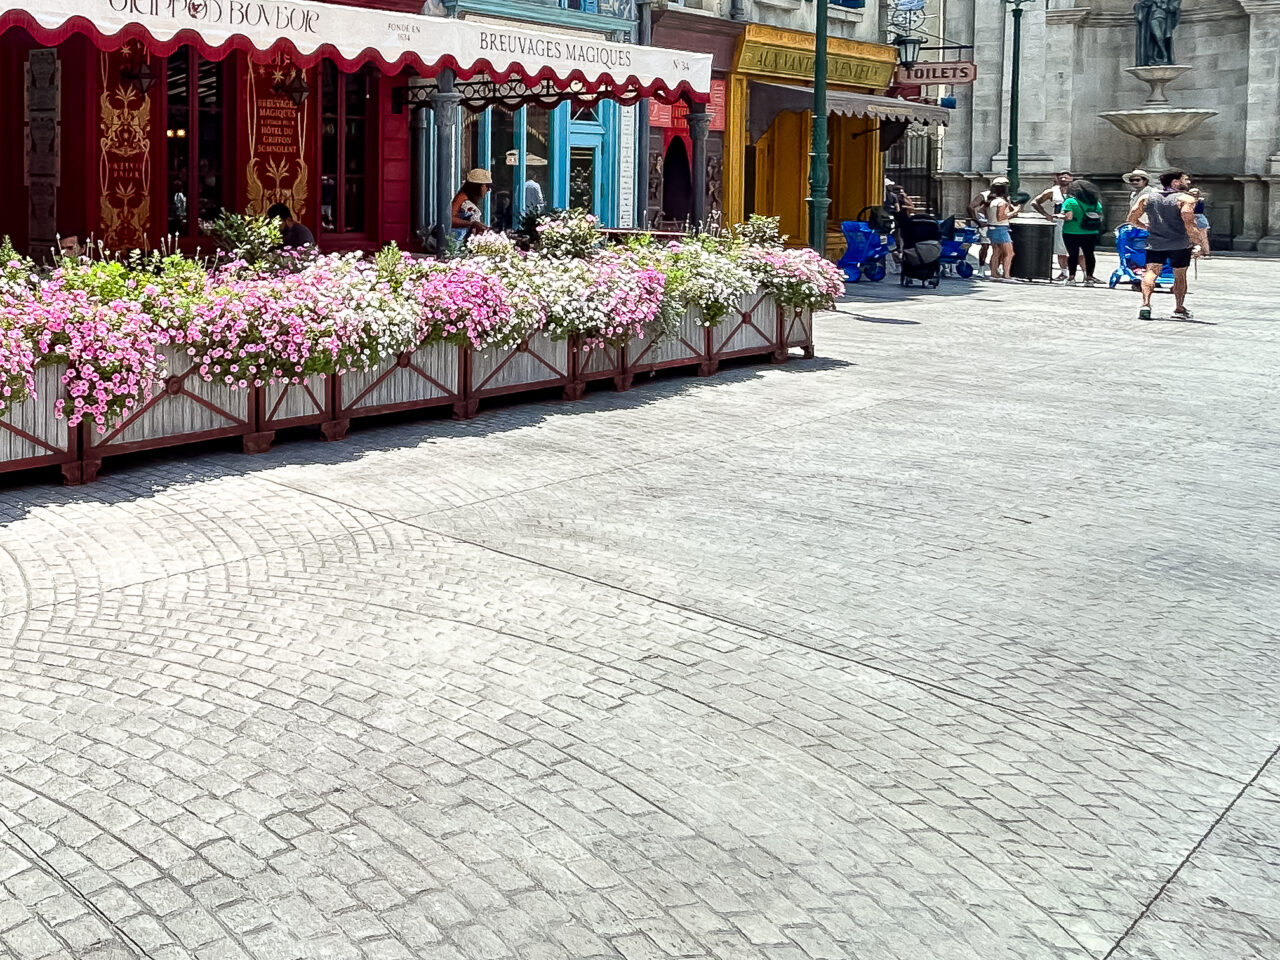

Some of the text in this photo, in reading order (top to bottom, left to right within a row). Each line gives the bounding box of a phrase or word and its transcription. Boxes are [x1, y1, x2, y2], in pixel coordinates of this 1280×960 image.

[479, 31, 632, 70] BREUVAGES MAGIQUES
[905, 66, 969, 80] TOILETS
